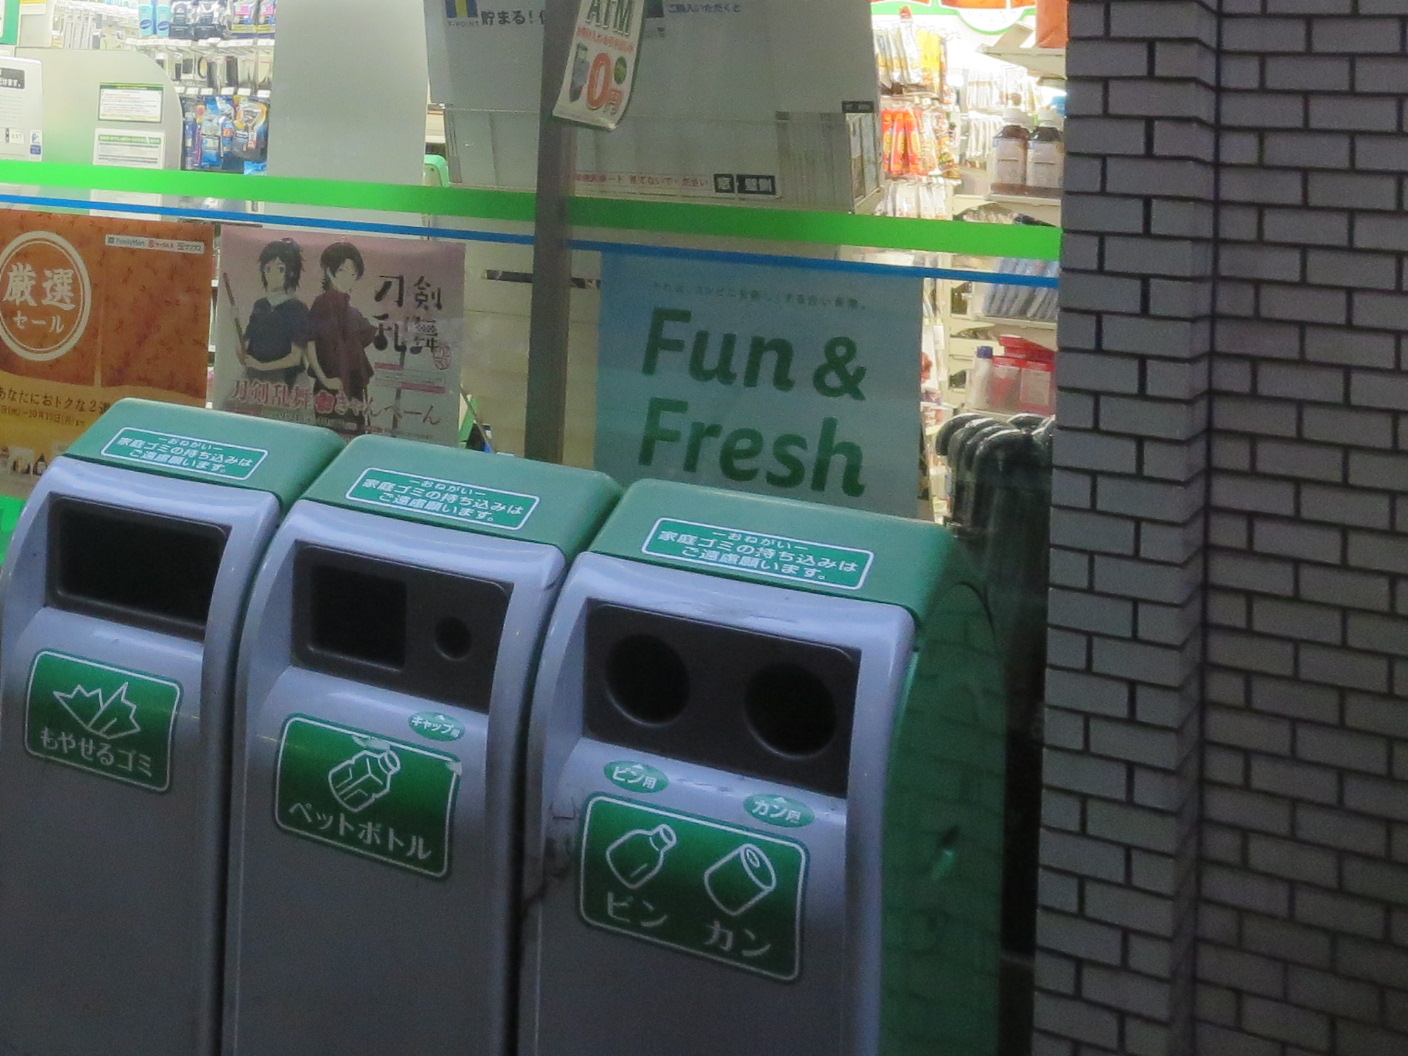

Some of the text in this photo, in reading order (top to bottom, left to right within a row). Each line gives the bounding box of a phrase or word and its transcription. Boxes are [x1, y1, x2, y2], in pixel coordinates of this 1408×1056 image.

[1, 262, 77, 310] 厳選
[12, 313, 64, 335] セール
[642, 307, 867, 401] Fun &
[116, 436, 254, 468] 家庭ゴミの持ち込みは
[127, 449, 228, 475] ご遠慮願います。
[638, 397, 866, 498] Fresh
[361, 477, 524, 517] 家庭ゴミの持ち込みは
[378, 492, 495, 523] ご遠慮願います。
[657, 530, 859, 573] 家庭ゴミの持ち込みは
[681, 546, 826, 580] ご遠慮願います。
[409, 716, 461, 739] キャップ用
[40, 725, 153, 778] もやせるゴミ
[612, 766, 658, 790] ビン用
[752, 799, 802, 824] カン用
[288, 801, 434, 862] ペットボトル
[607, 891, 669, 927] ビン
[704, 920, 772, 957] カン
